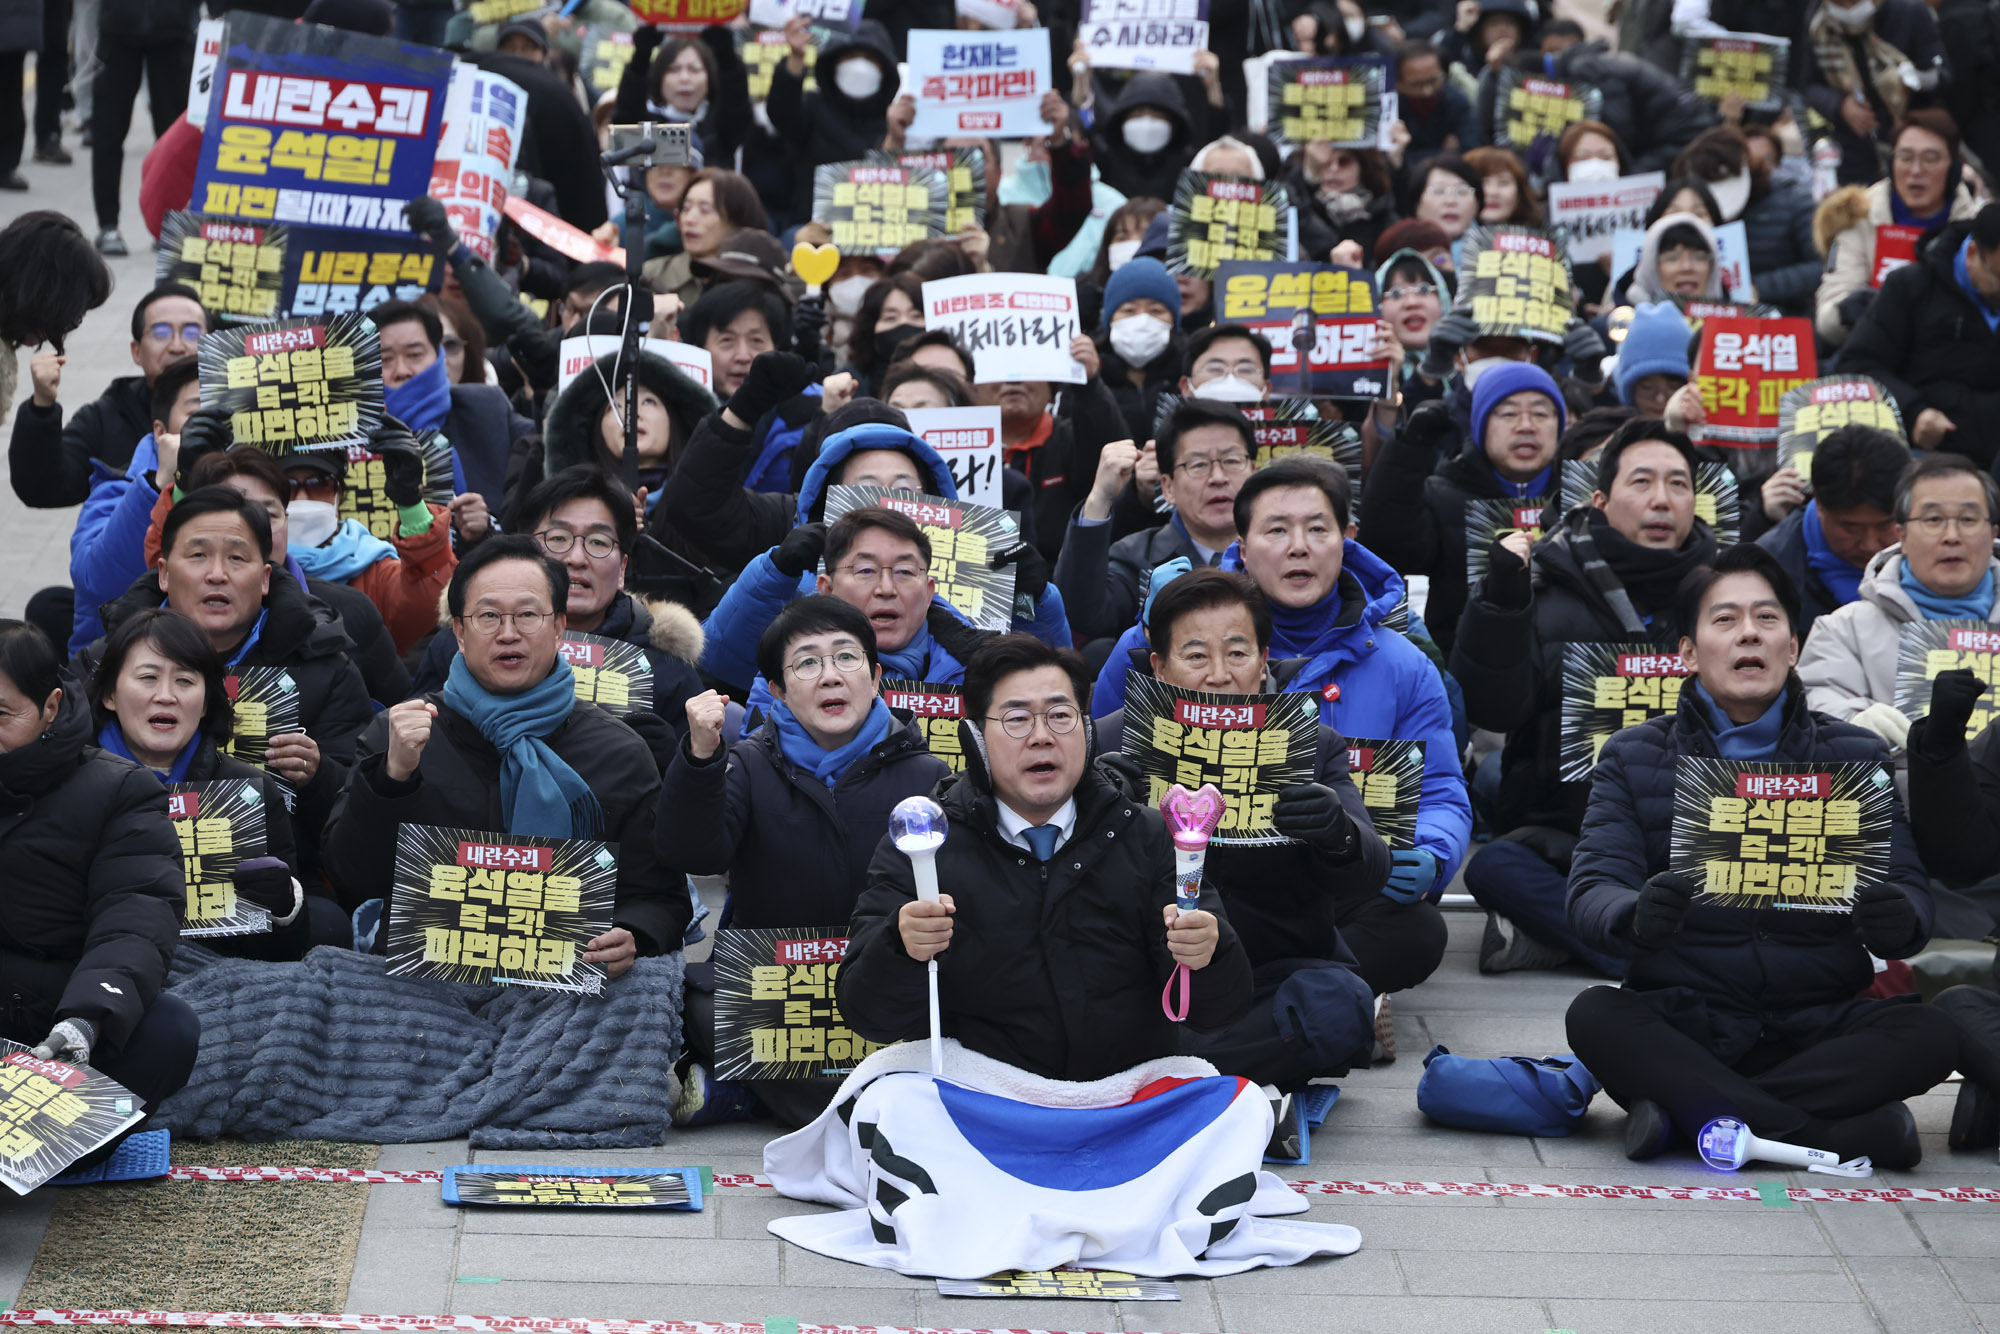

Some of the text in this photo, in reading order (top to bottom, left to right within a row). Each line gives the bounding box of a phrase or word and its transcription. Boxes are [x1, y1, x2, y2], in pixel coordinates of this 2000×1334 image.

[943, 43, 1017, 70] 헌재는
[224, 72, 429, 136] 내란수괴
[216, 125, 396, 186] 윤석열!
[299, 251, 435, 286] 내란종식
[1224, 270, 1374, 319] 윤석열을
[252, 328, 315, 352] 내란수괴
[1713, 332, 1799, 372] 윤석열
[227, 346, 355, 389] 윤석열을
[1697, 375, 1750, 416] 즉각
[231, 401, 359, 444] 파면하라
[891, 694, 960, 715] 내란수괴
[1183, 704, 1254, 726] 내란수괴
[1153, 715, 1290, 766] 윤석열을
[1746, 775, 1818, 796] 내란수괴
[1709, 796, 1861, 836] 윤석열을
[466, 845, 539, 868] 내란수괴
[429, 864, 582, 913] 윤석열을
[1703, 860, 1858, 899] 파면하라
[423, 927, 576, 975] 파면하라
[751, 1026, 895, 1062] 파면하
[12, 1053, 75, 1083] 내란수괴
[485, 1319, 590, 1330] DANGER!
